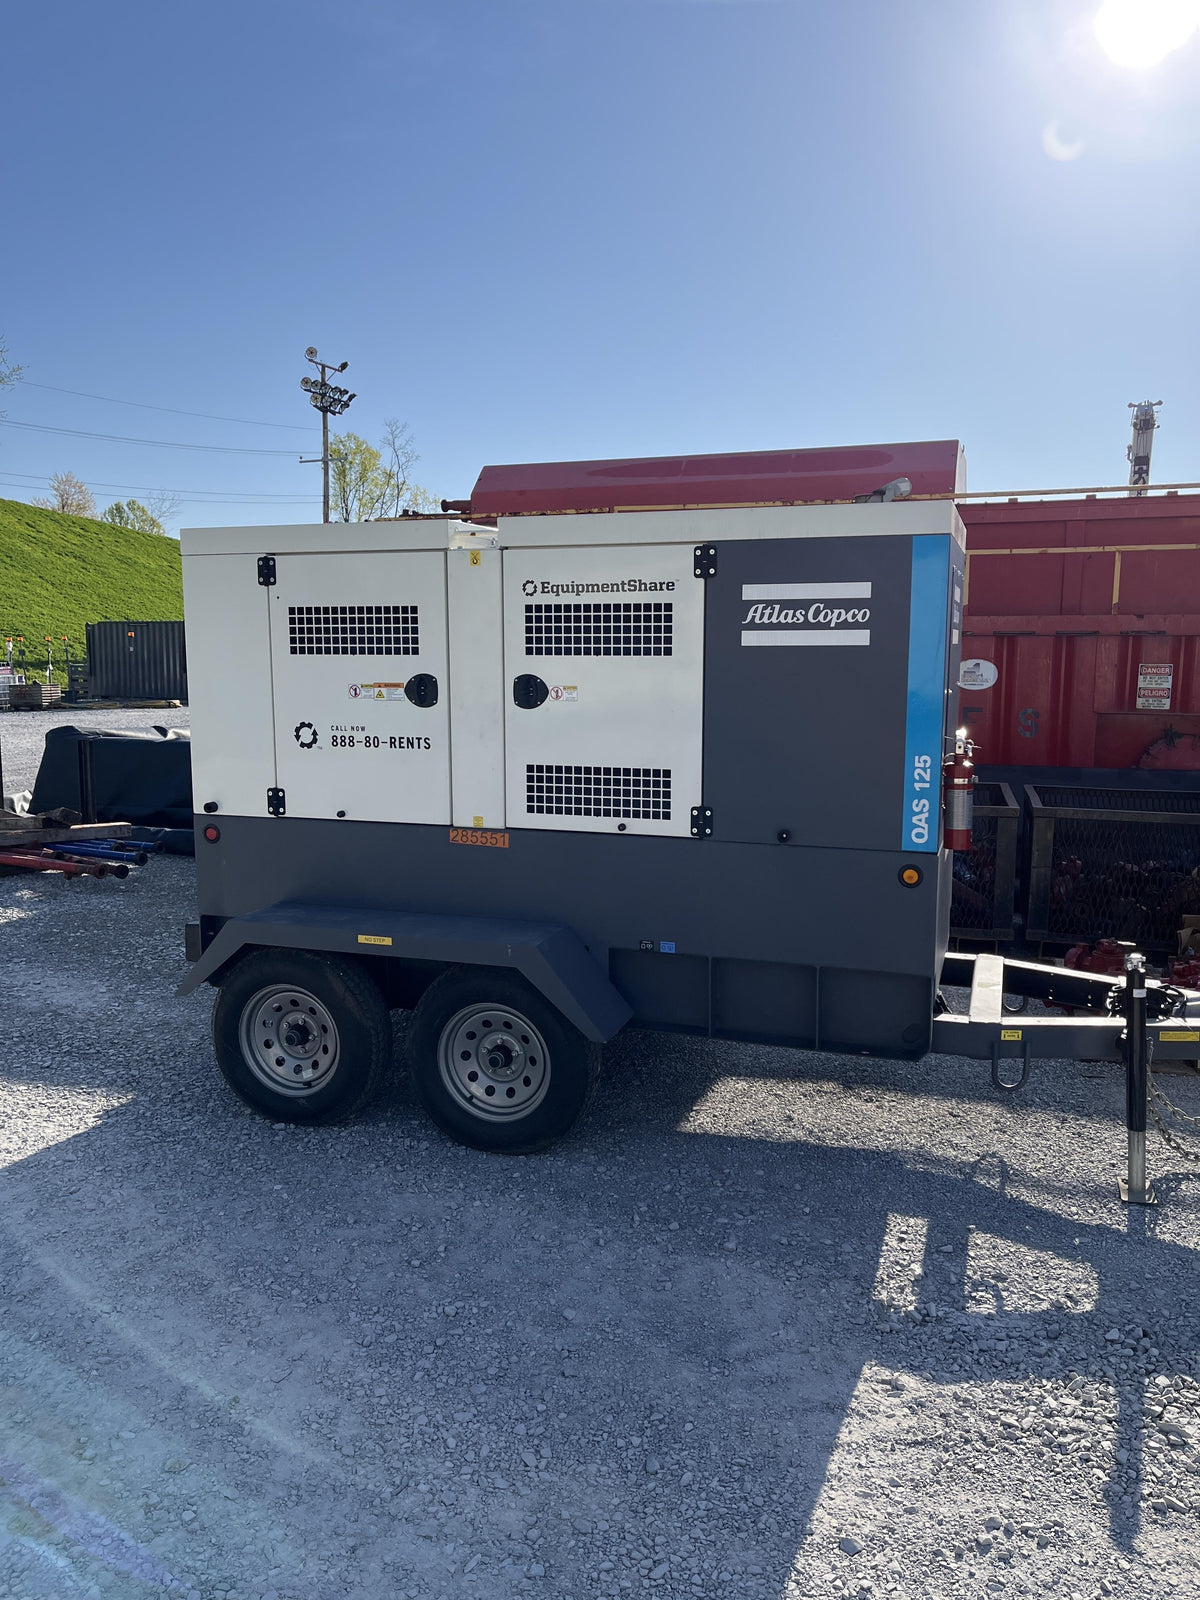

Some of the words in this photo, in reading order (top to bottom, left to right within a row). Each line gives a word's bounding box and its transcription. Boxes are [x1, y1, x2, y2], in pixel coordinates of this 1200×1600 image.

[540, 579, 676, 597] EquipmentShare
[741, 603, 806, 624] Atlas
[807, 603, 871, 627] Copco
[1140, 689, 1168, 697] PELIGRO
[331, 734, 432, 750] 888-80-RENTS
[913, 755, 932, 791] 125
[911, 798, 930, 844] QAS
[451, 829, 506, 846] 285551
